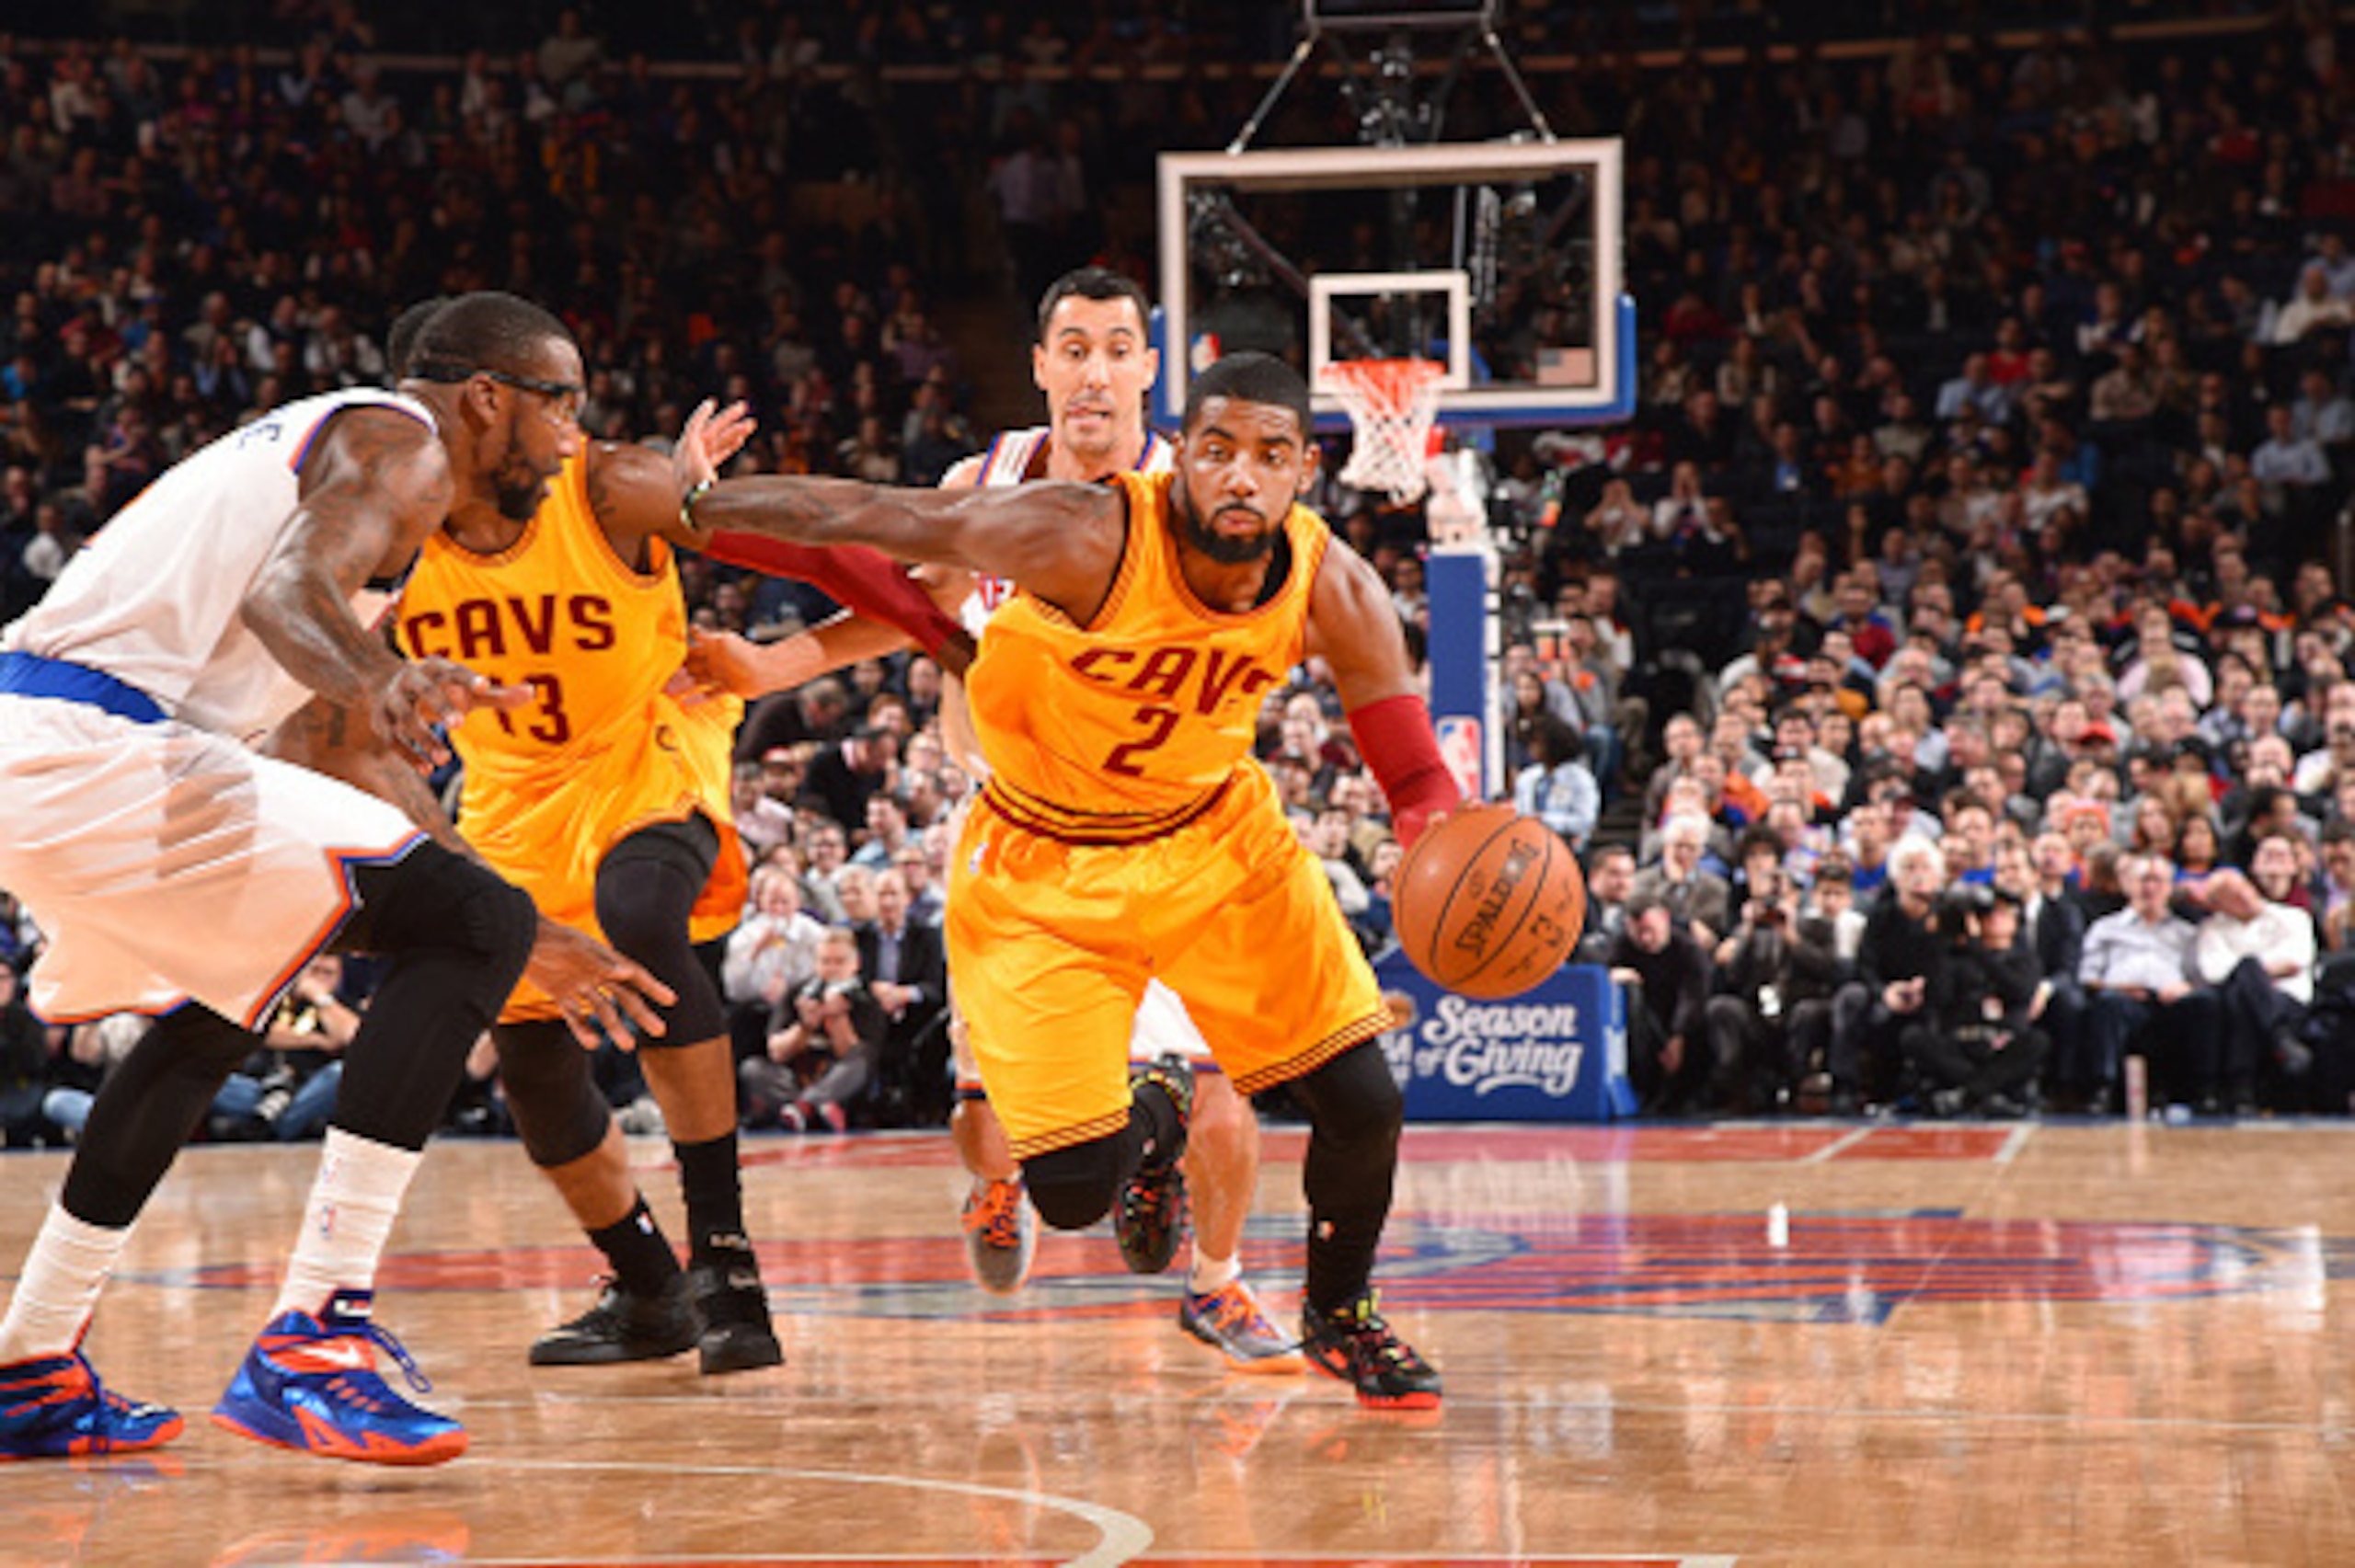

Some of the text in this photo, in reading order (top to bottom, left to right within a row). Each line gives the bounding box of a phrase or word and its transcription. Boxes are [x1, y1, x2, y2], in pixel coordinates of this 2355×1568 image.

[406, 593, 616, 659] CAVS
[1101, 706, 1180, 778] 2
[1454, 837, 1541, 960] SPALDG
[1421, 994, 1578, 1046] Season
[1444, 1038, 1582, 1098] Giving
